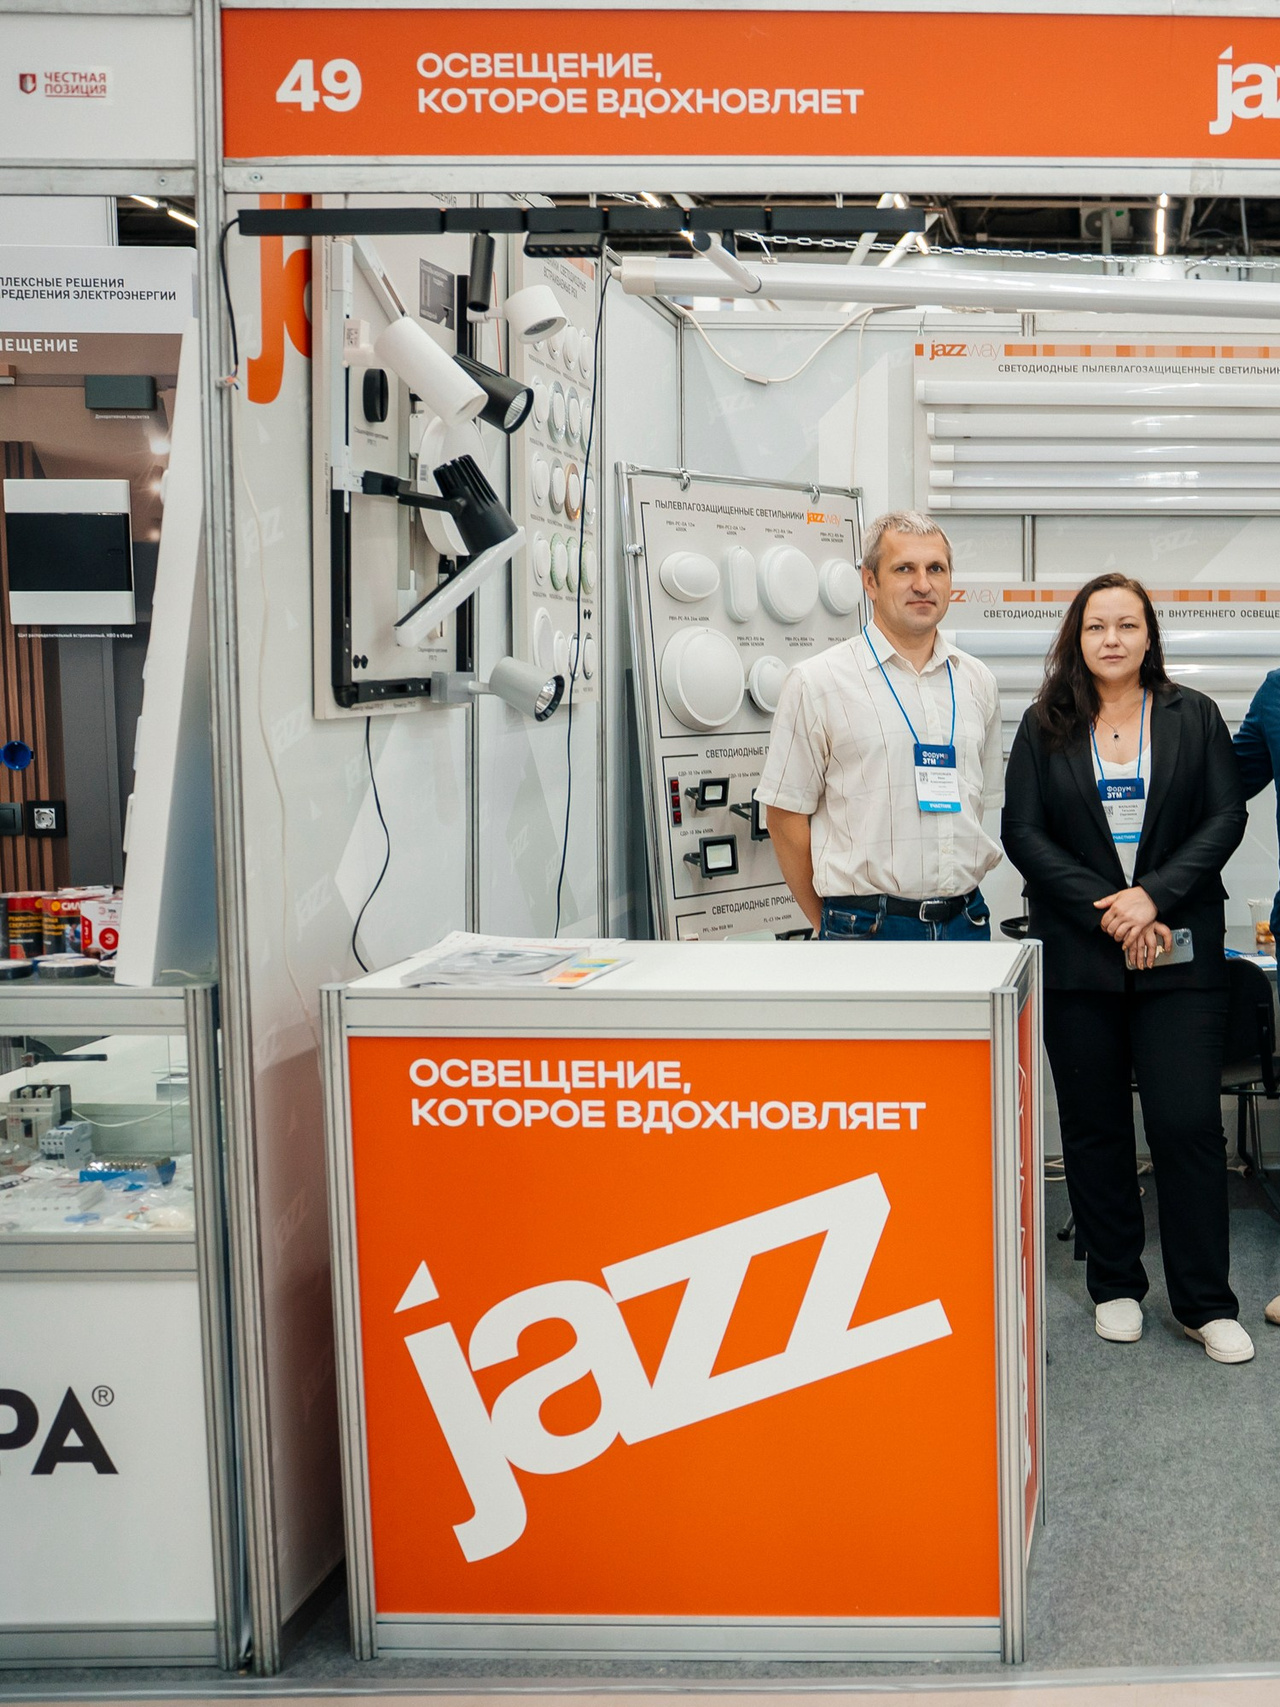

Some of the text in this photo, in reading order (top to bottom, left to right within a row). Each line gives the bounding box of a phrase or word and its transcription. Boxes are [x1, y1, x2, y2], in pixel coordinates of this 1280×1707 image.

[417, 52, 662, 83] ОСВЕЩЕНИЕ,
[44, 71, 107, 84] ЧЕСТНАЯ
[275, 58, 362, 113] 49
[44, 83, 107, 95] ПОЗИЦИЯ
[418, 88, 863, 118] КОТОРОЕ ВДОХНОВЛЯЕТ
[66, 278, 125, 288] РЕШЕНИЯ
[73, 290, 176, 301] ЭЛЕКТРОЭНЕРГИИ
[0, 338, 78, 353] ЕЩЕНИЕ
[929, 339, 1002, 361] jazzway
[998, 363, 1078, 376] СВЕТОДИОДНЫЕ
[1082, 364, 1215, 376] ПЫЛЕВЛАГОЗАЩИЩЕННЫЕ
[655, 500, 805, 520] ПЫЛЕВЛАГОЗАЩИЩЕННЫЕ СВЕТИЛЬНИКИ
[807, 509, 841, 527] jazzway
[983, 609, 1063, 620] СВЕТОДИОДНЫЕ
[1168, 609, 1235, 619] ВНУТРЕННЕГО
[706, 747, 764, 759] СВЕТОДИОДНЫЕ
[1106, 785, 1131, 793] Форум
[712, 898, 769, 915] СВЕТОДИОДНЫЕ
[409, 1059, 691, 1094] ОСВЕЩЕНИЕ,
[411, 1098, 926, 1134] КОТОРОЕ ВДОХНОВЛЯЕТ
[394, 1172, 953, 1563] jazz
